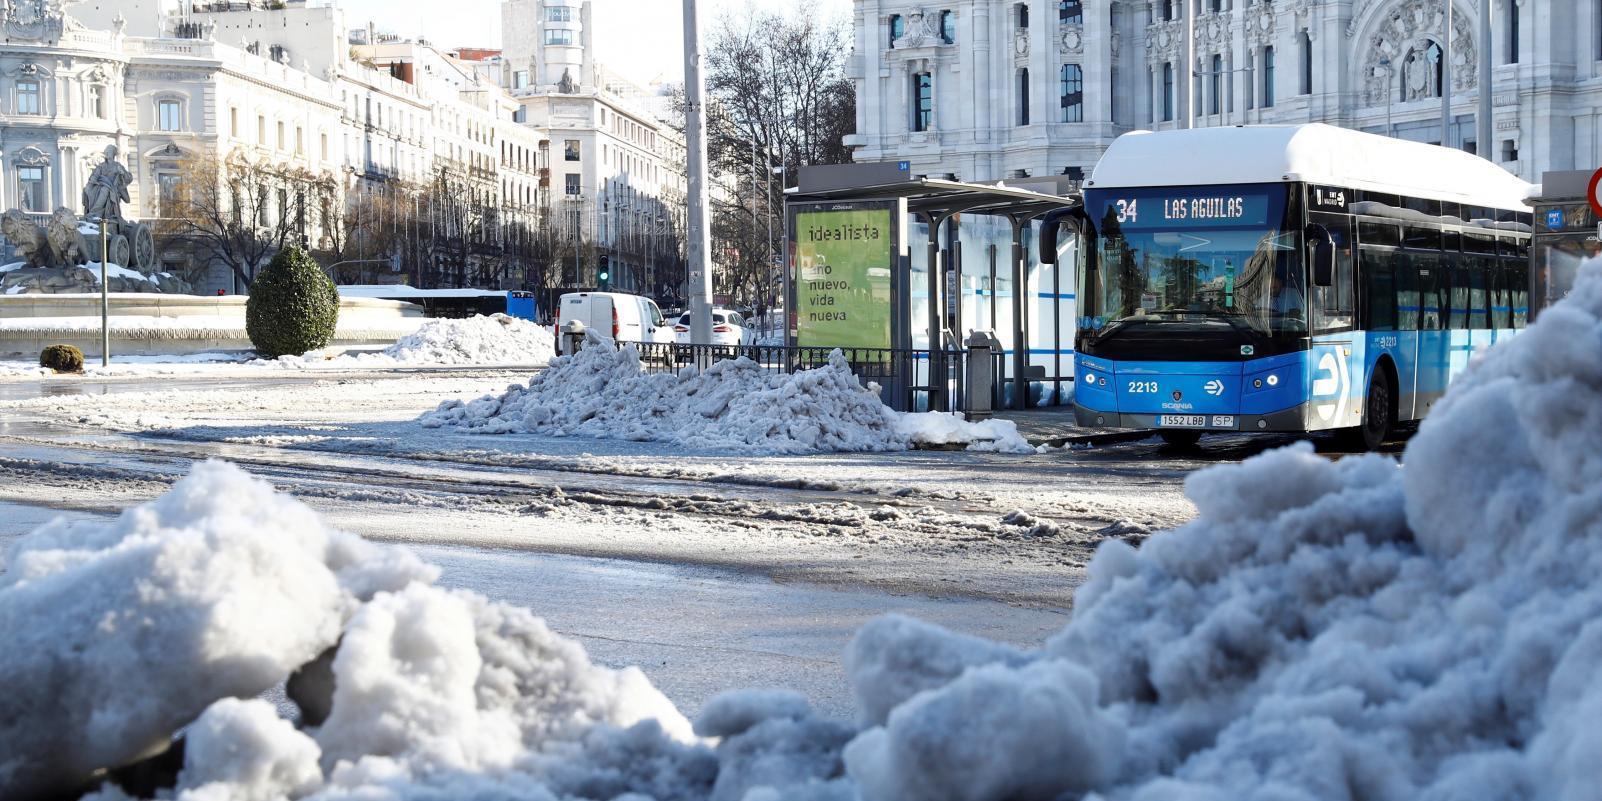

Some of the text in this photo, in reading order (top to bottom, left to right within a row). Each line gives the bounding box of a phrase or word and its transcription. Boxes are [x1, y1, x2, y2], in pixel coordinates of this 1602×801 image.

[1116, 197, 1243, 223] 34 LAS AGUILAS
[809, 223, 879, 242] idealista
[809, 279, 850, 291] nuevo,
[809, 294, 835, 306] vida
[809, 311, 847, 322] nueva
[1386, 336, 1397, 347] 2213
[1128, 381, 1158, 393] 2213
[1161, 402, 1193, 410] SCANIA
[1163, 416, 1204, 426] 1552 LBB
